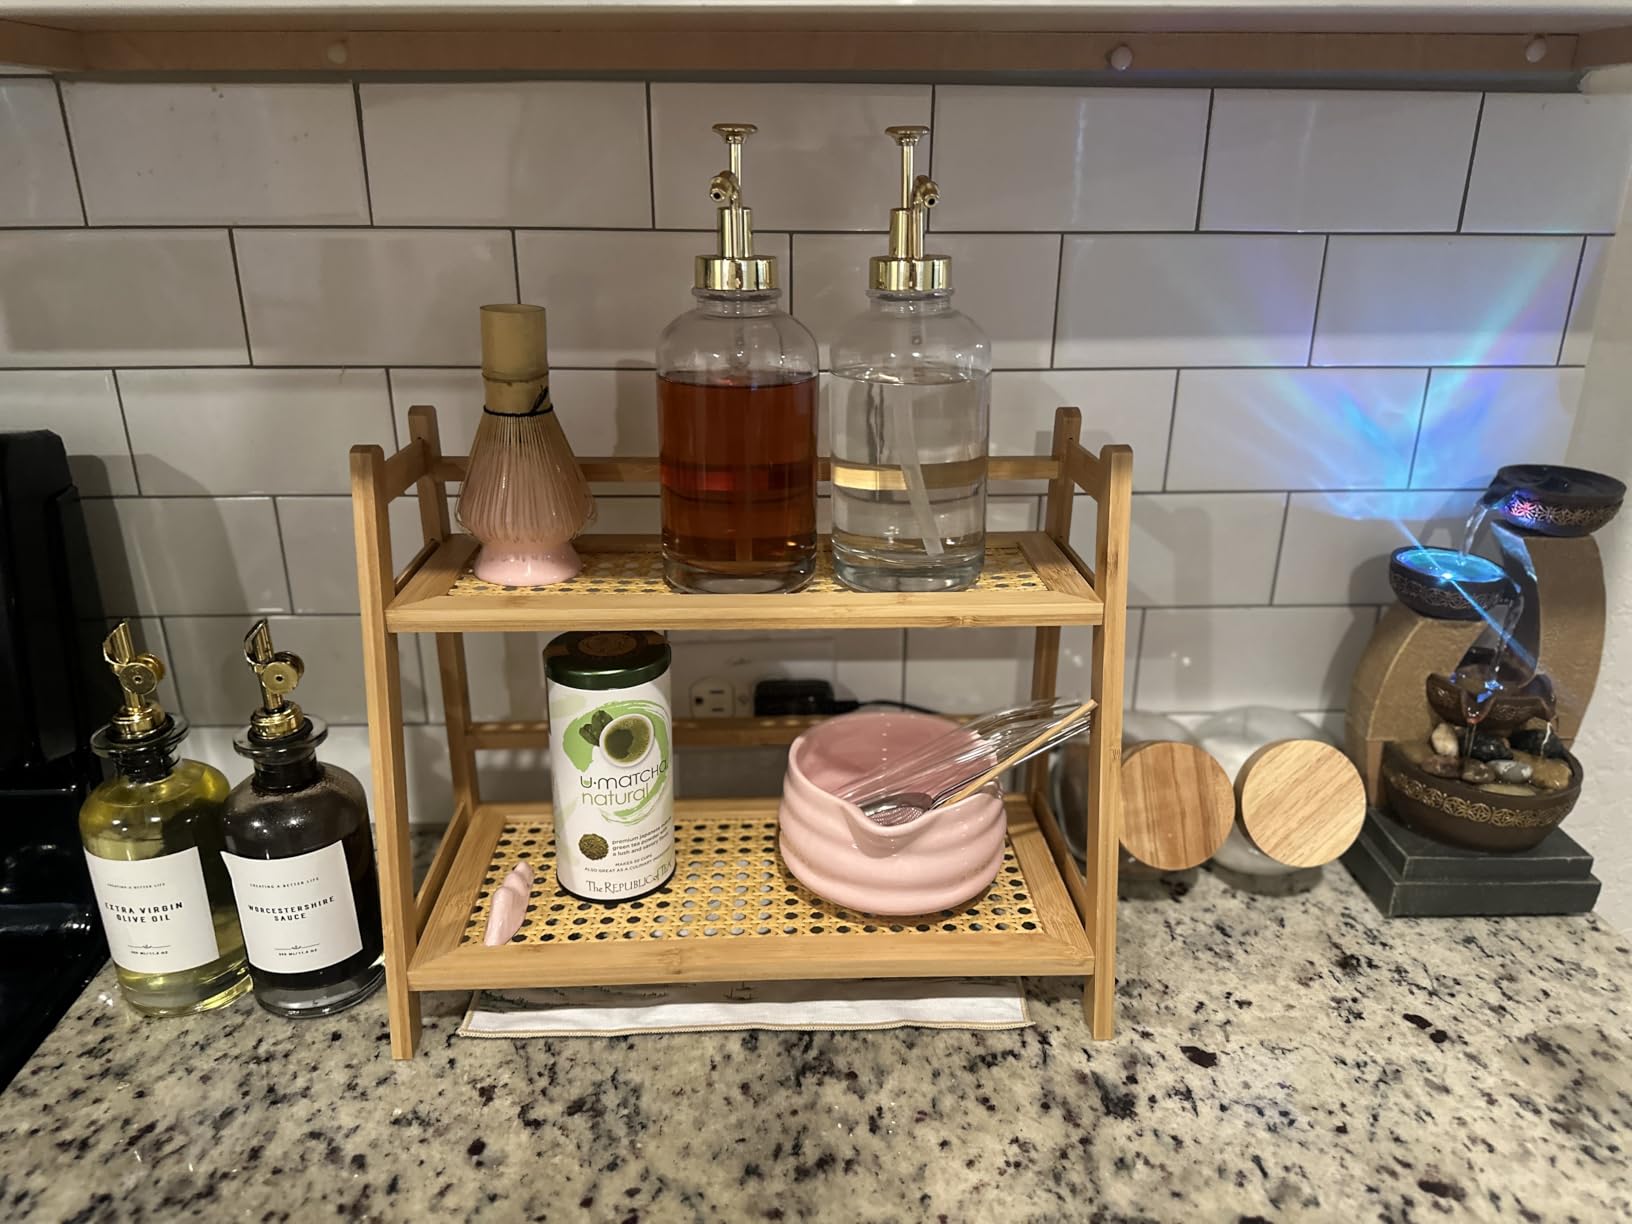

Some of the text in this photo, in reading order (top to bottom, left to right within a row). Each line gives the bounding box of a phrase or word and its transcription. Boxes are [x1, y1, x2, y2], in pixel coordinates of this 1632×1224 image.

[582, 783, 649, 806] natural
[612, 835, 639, 845] premium
[585, 880, 603, 893] The
[604, 874, 653, 894] REPUBLIC
[105, 901, 183, 914] EXTRA VIRGIN
[248, 896, 334, 914] WORCESTERSHIRE
[116, 914, 170, 923] OLIVE OIL
[274, 913, 307, 922] SAUCE
